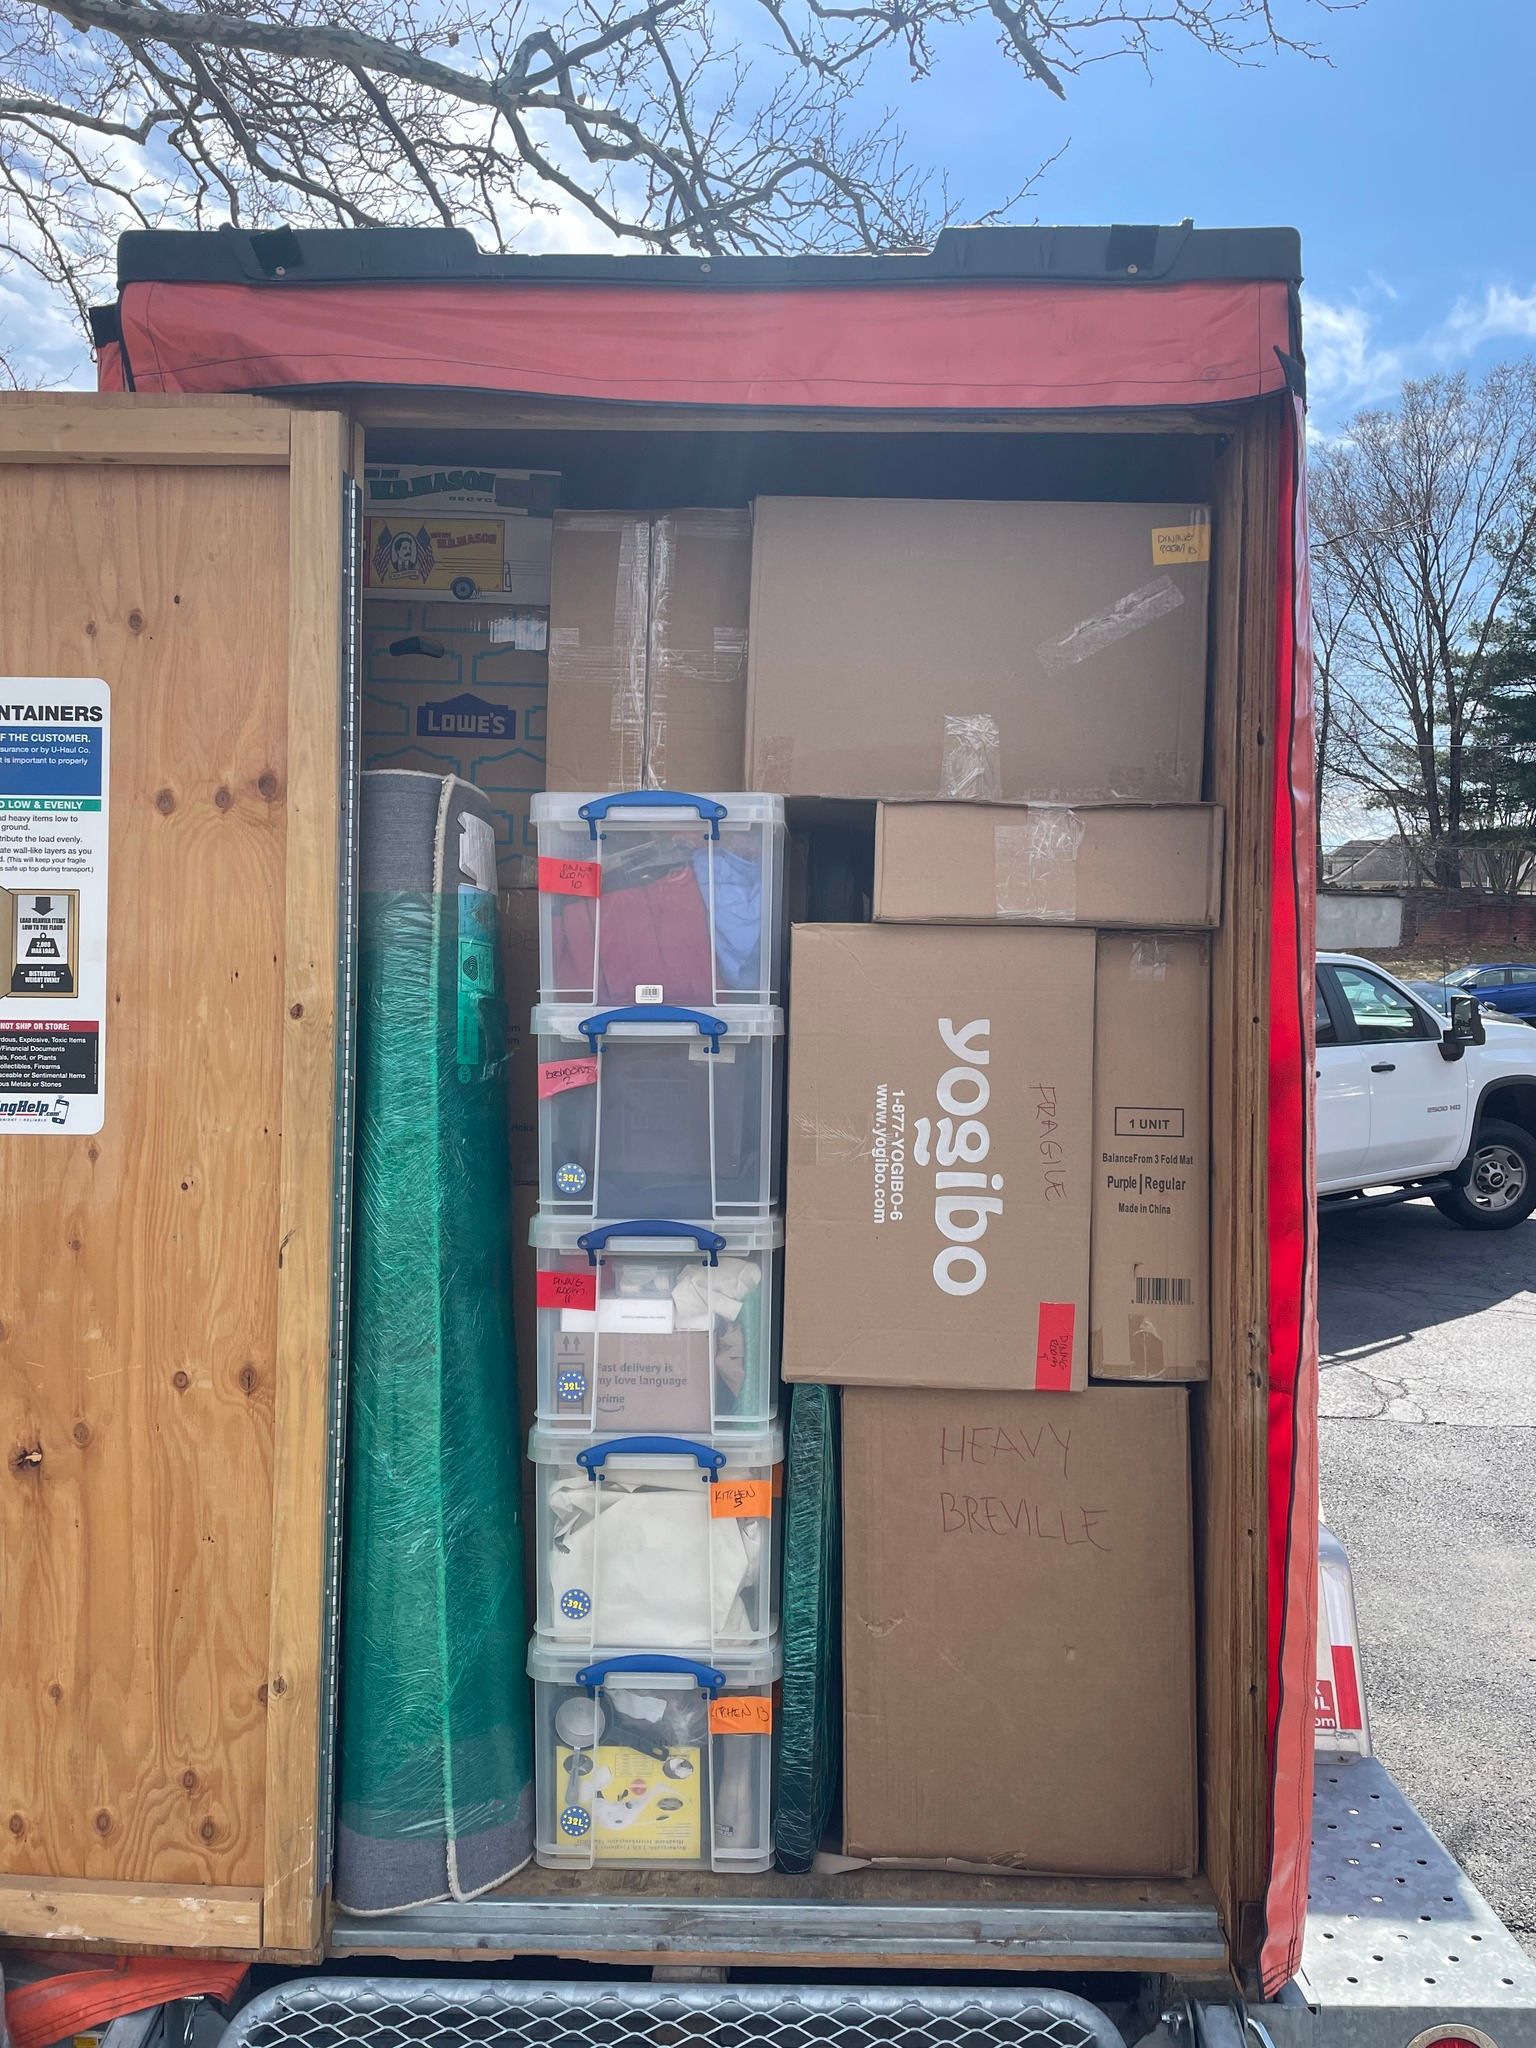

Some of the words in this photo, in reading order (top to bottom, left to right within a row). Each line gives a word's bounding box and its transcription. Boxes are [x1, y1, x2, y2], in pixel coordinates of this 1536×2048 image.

[428, 709, 505, 735] LOWE'S
[8, 733, 29, 742] THE
[30, 733, 91, 743] CUSTOMER.
[40, 746, 50, 755] by
[51, 746, 77, 754] U-Haul
[78, 746, 91, 754] Co.
[4, 756, 11, 764] is
[12, 756, 47, 766] important
[48, 757, 57, 765] to
[58, 757, 89, 766] properly
[8, 801, 31, 809] LOW
[33, 801, 41, 809] &
[44, 801, 84, 810] EVENLY
[8, 814, 31, 824] heavy
[32, 815, 54, 823] items
[55, 815, 69, 823] low
[70, 815, 79, 823] to
[1, 824, 31, 832] ground.
[24, 835, 37, 843] the
[38, 835, 55, 843] load
[56, 836, 83, 845] evenly.
[44, 847, 67, 856] layers
[35, 856, 50, 864] keep
[51, 857, 66, 865] your
[67, 856, 87, 865] fragile
[28, 865, 39, 873] top
[40, 865, 61, 874] during
[15, 1022, 32, 1030] SHIP
[33, 1022, 43, 1030] OR
[44, 1022, 70, 1030] STORE:
[19, 1036, 50, 1044] Explosive,
[1426, 1105, 1448, 1113] 2500
[1129, 1119, 1135, 1129] 1
[1139, 1119, 1170, 1130] UNIT
[872, 1083, 889, 1223] www.yogibo.com
[890, 1089, 905, 1221] 1-877-YOGIBO-6
[914, 1018, 1004, 1296] yogibo
[1102, 1152, 1153, 1164] BalanceFrom
[1154, 1154, 1160, 1164] 3
[1160, 1154, 1178, 1165] Fold
[1179, 1155, 1194, 1165] Mat
[1107, 1175, 1137, 1191] Purple
[1144, 1176, 1187, 1193] Regular
[1118, 1203, 1139, 1214] Made
[1139, 1203, 1148, 1214] in
[1148, 1204, 1172, 1215] China
[619, 1362, 662, 1374] delivery
[664, 1362, 673, 1373] is
[614, 1376, 637, 1386] love
[639, 1376, 688, 1388] language
[940, 1422, 1071, 1480] HEAVY
